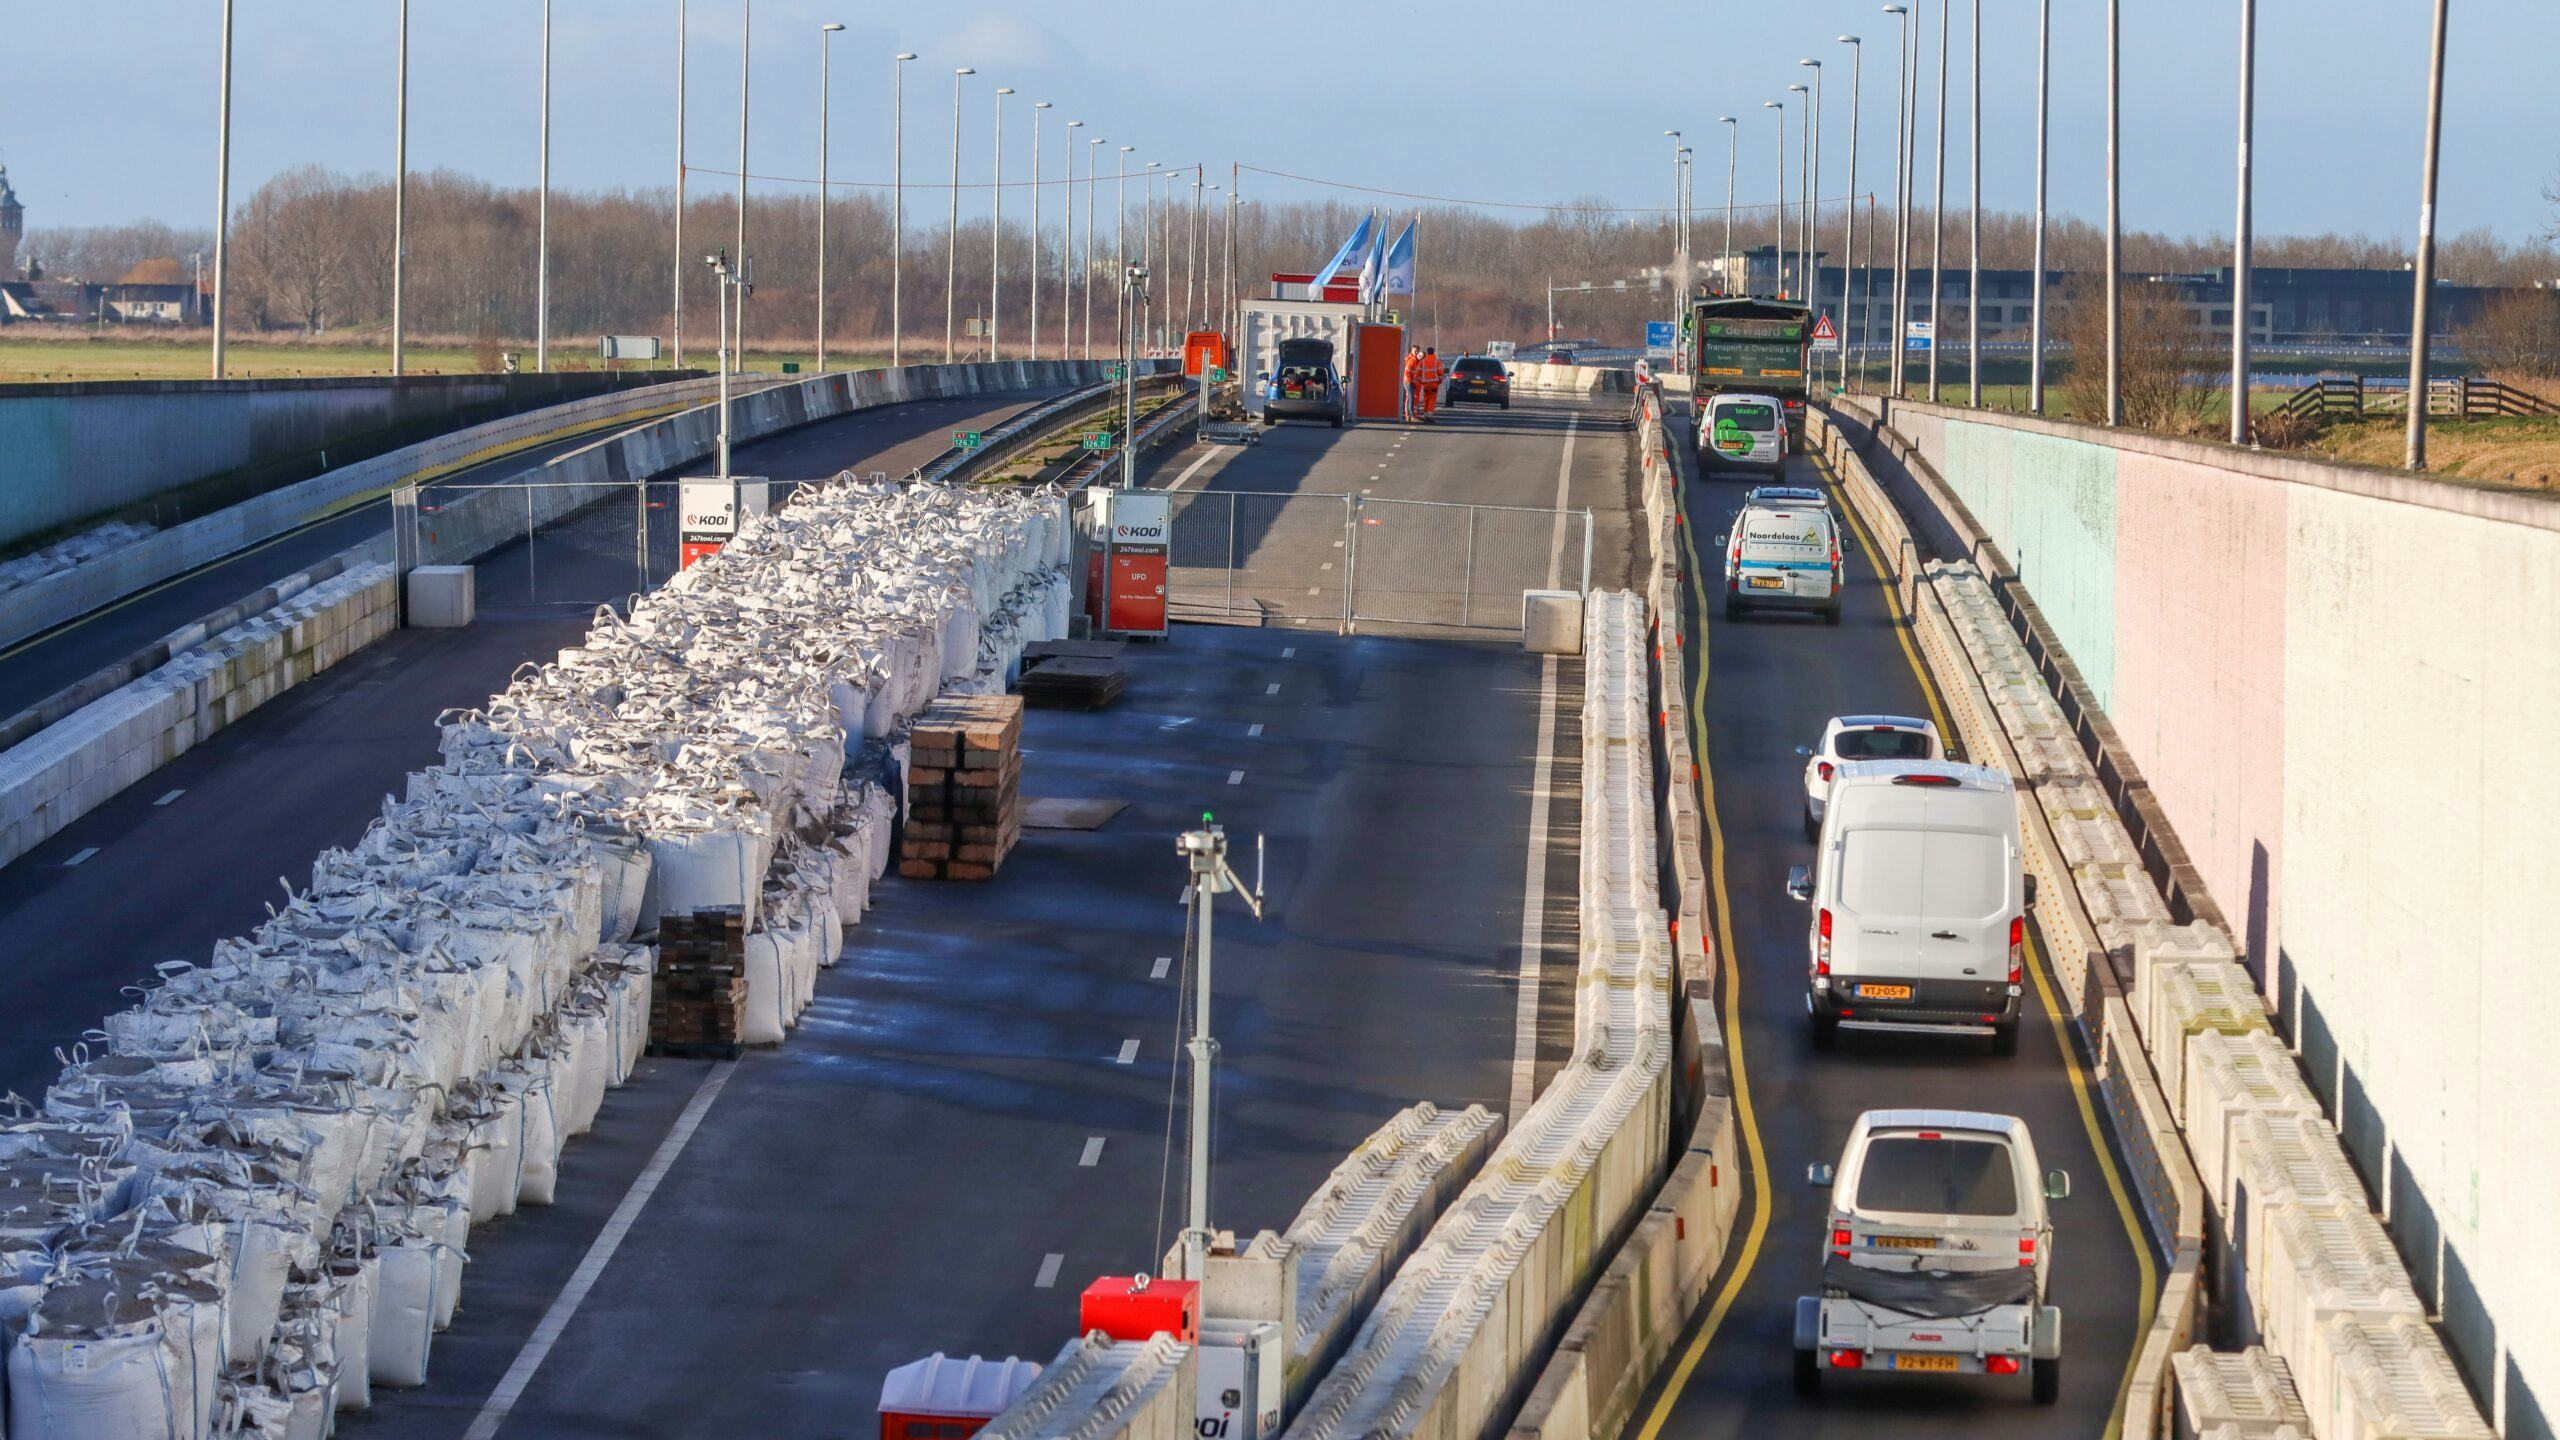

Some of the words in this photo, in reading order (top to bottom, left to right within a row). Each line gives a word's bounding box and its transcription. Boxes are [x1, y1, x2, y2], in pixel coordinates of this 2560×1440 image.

[1706, 343, 1742, 353] Transport
[1749, 531, 1800, 541] Noordeloos
[1131, 573, 1147, 581] UFO
[1864, 986, 1906, 996] VTJ-05-P
